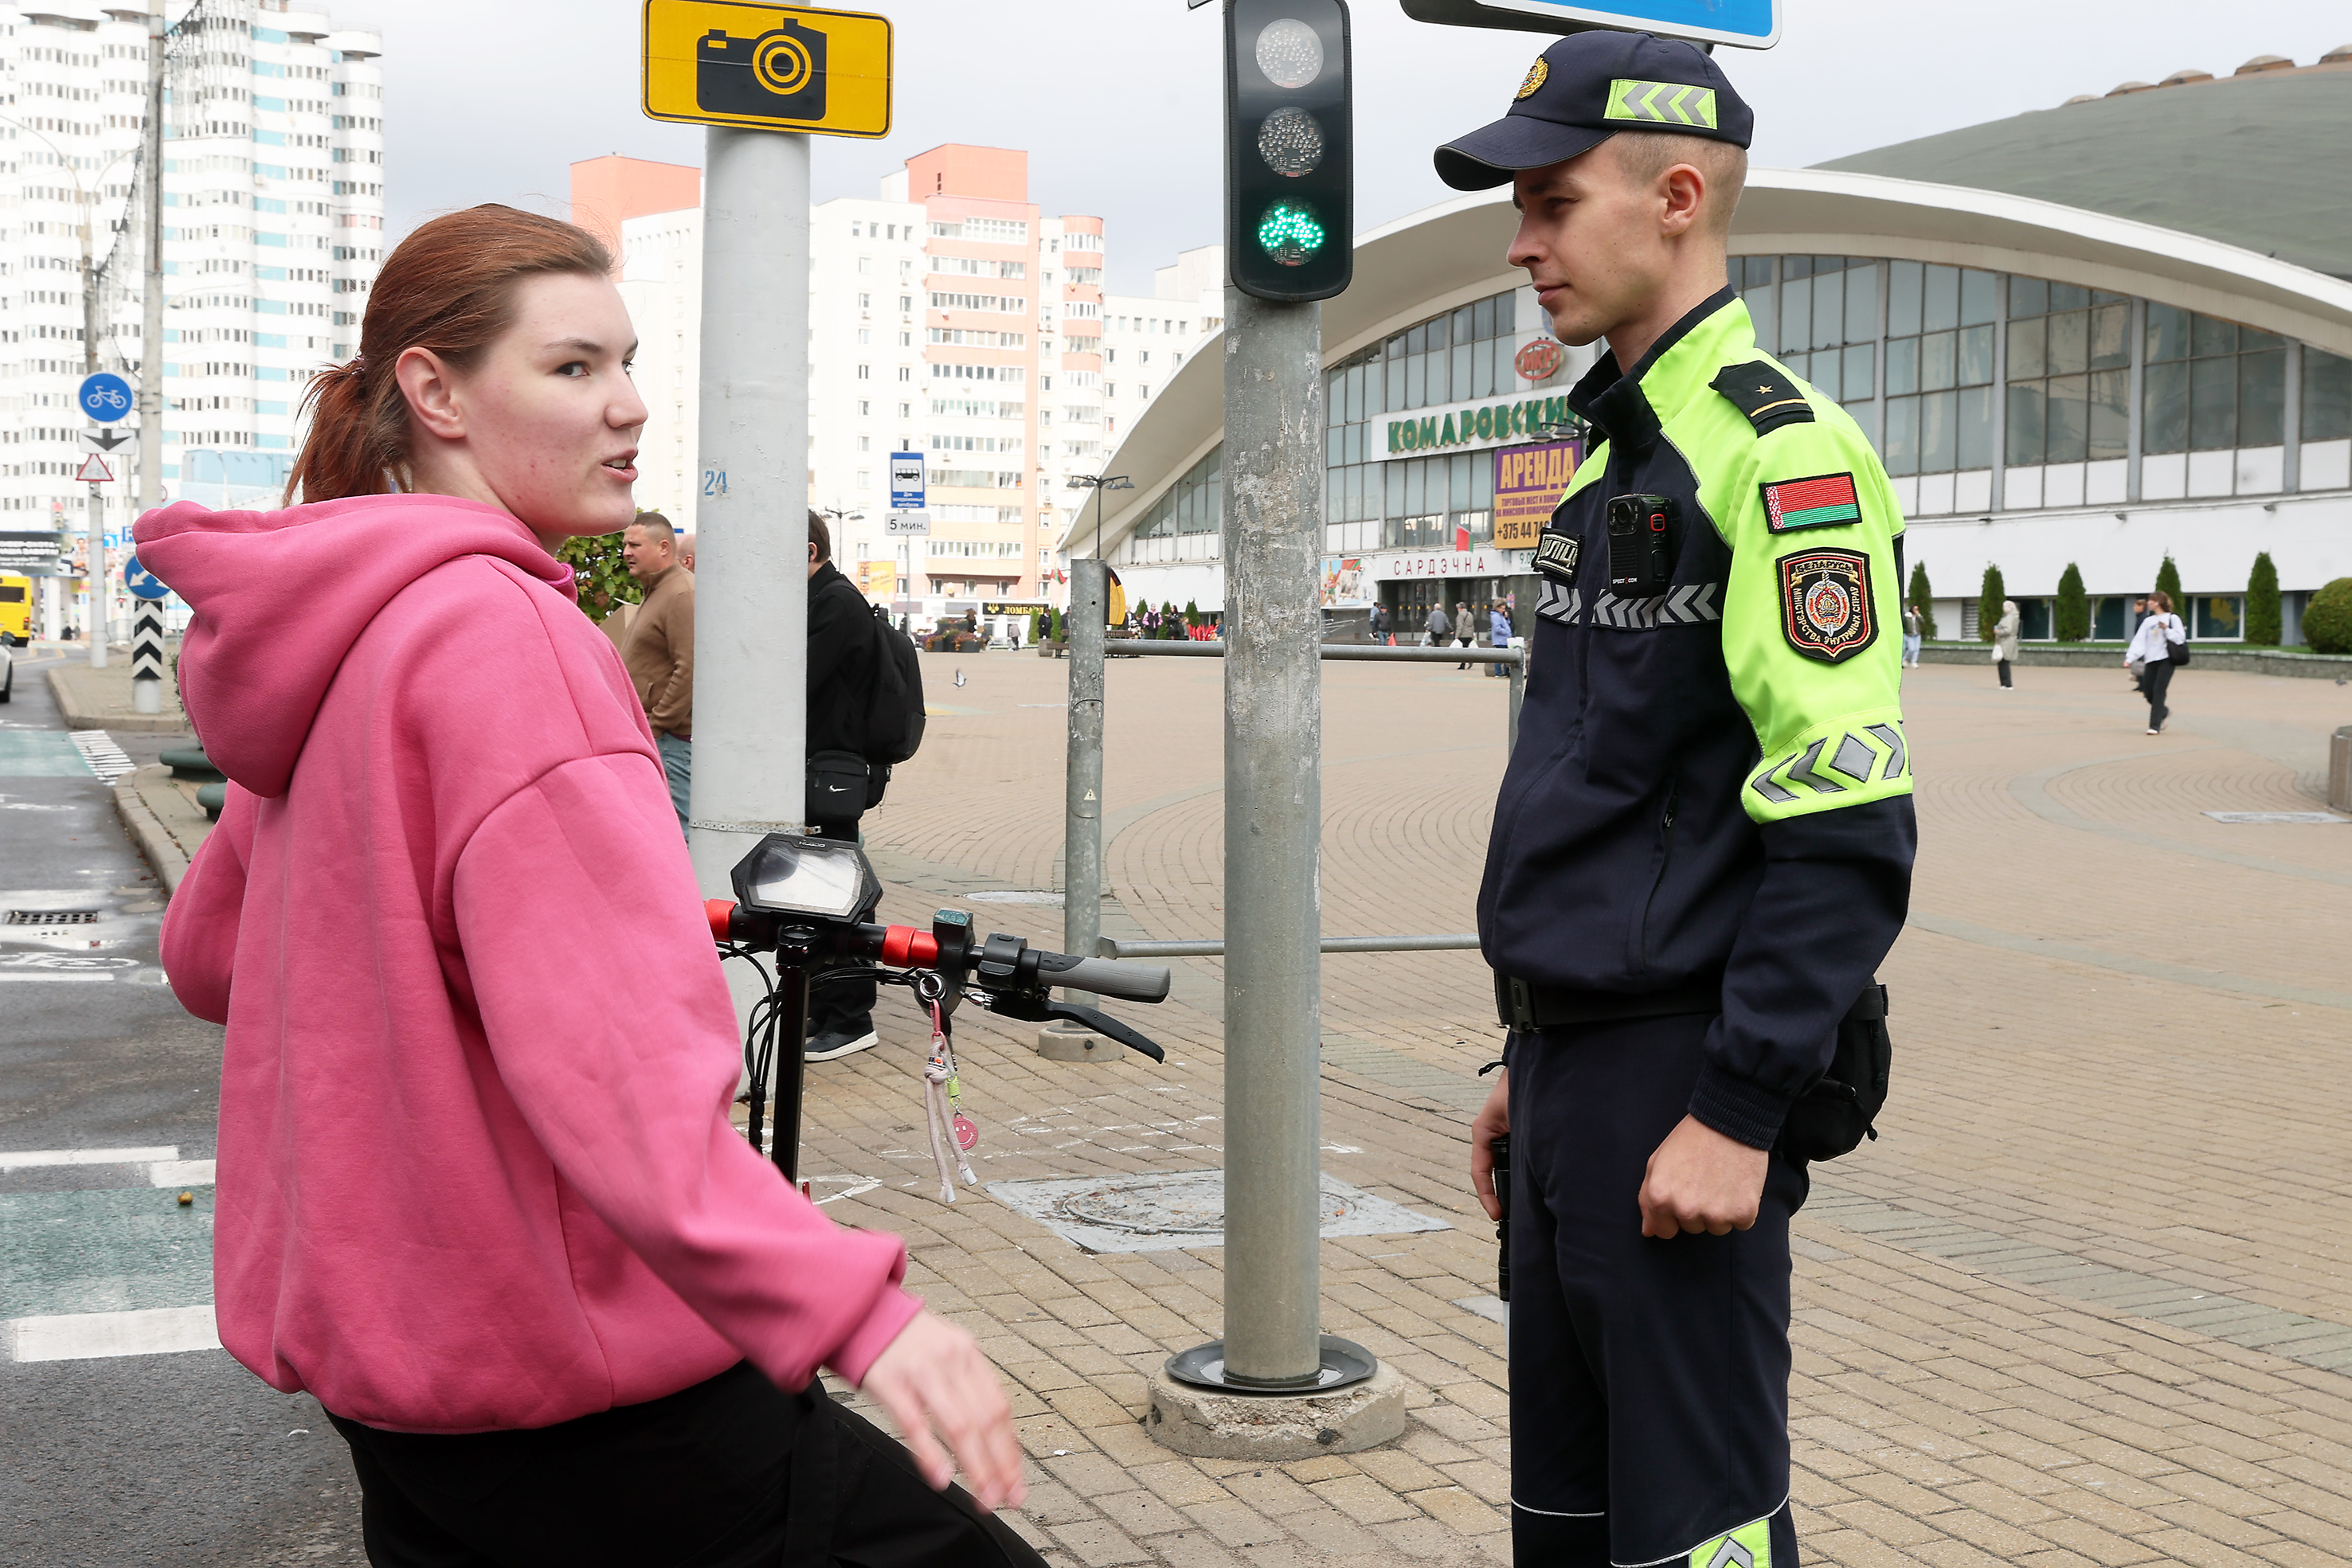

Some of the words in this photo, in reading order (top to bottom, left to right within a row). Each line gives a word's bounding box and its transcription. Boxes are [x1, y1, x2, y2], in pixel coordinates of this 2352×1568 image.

[1522, 347, 1554, 372] МКР
[1501, 447, 1575, 490] АРЕНДА
[704, 471, 727, 495] 24
[890, 519, 897, 530] 5
[1497, 522, 1518, 539] +375
[1520, 520, 1532, 538] 44
[1394, 557, 1484, 576] САРДЭЧНА
[1797, 561, 1852, 571] БЕЛАРУСЬ
